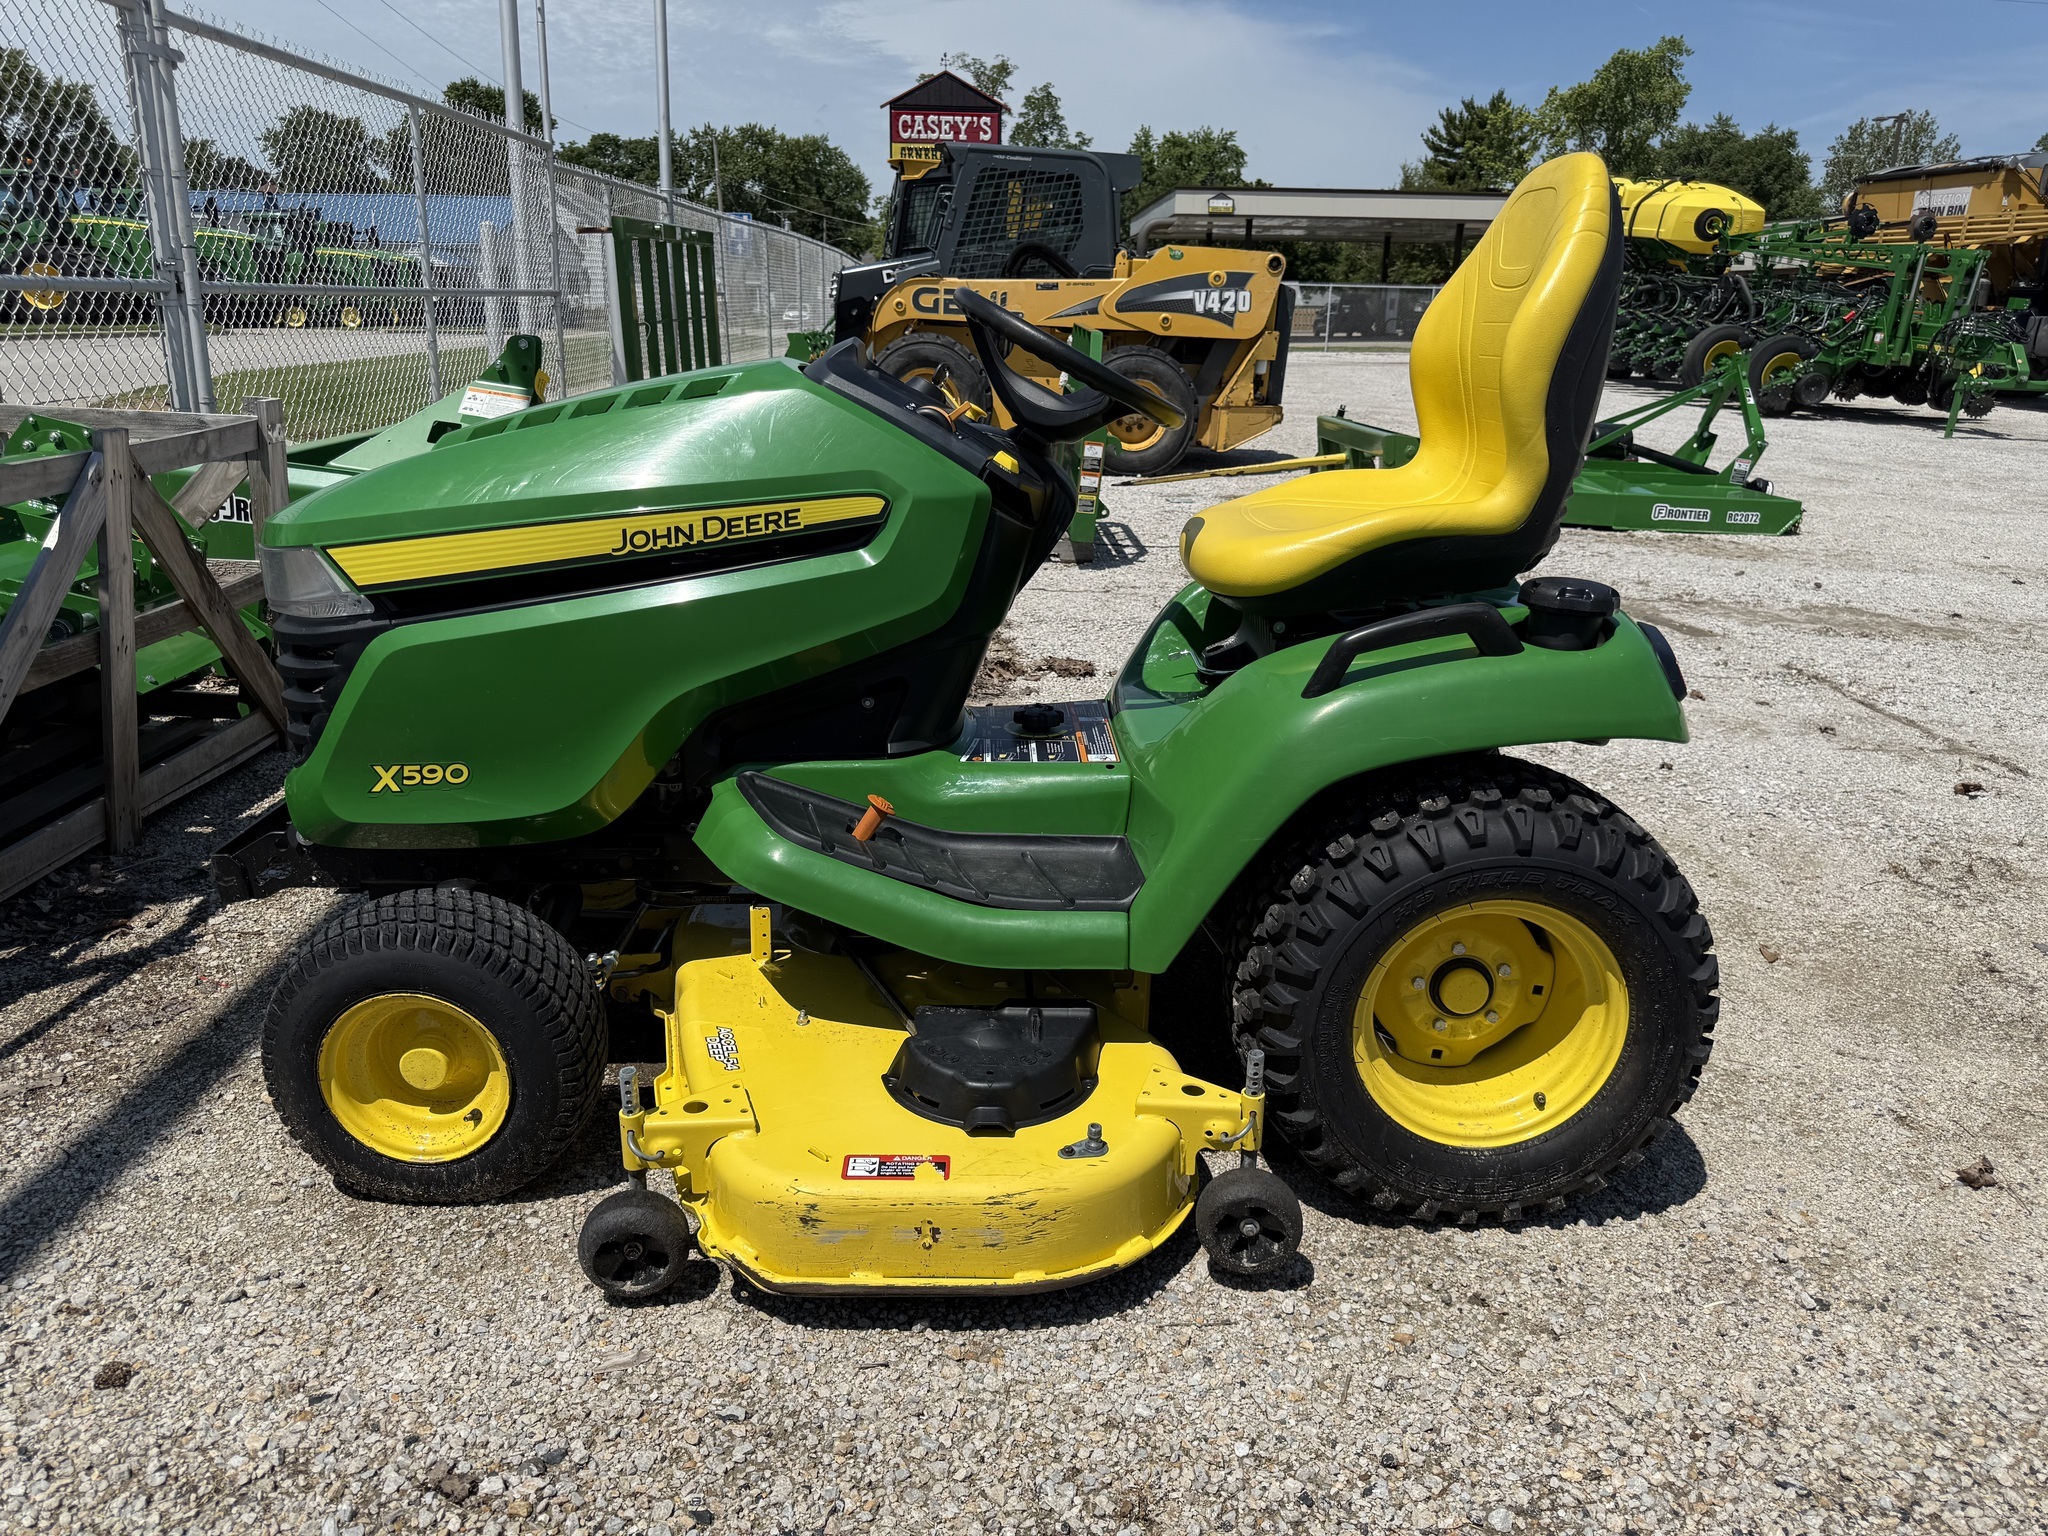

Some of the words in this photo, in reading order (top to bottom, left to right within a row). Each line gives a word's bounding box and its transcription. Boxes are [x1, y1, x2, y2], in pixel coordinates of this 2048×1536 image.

[898, 114, 992, 141] CASEY'S
[1946, 204, 1967, 216] BIN
[1194, 290, 1251, 313] V420
[1652, 504, 1710, 522] FRONTIER
[1727, 512, 1760, 524] RC2072
[611, 523, 697, 554] JOHN
[702, 508, 804, 543] DEERE
[368, 763, 470, 793] X590
[705, 1036, 725, 1063] DEEP
[716, 1025, 739, 1059] ACCEL
[723, 1057, 740, 1071] 54
